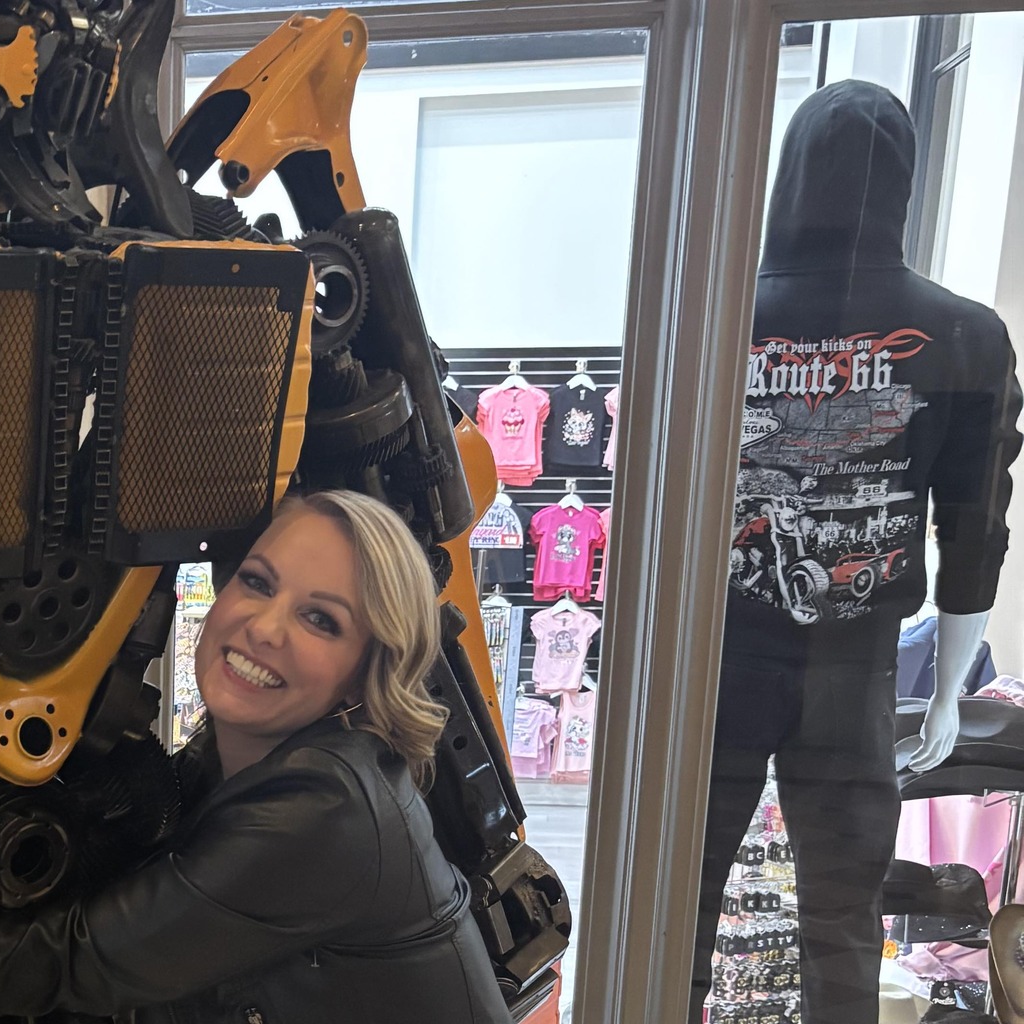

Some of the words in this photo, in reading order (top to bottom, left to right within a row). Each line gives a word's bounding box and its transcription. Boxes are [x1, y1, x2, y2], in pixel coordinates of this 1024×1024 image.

[765, 341, 787, 355] Get
[791, 342, 823, 356] your
[821, 339, 853, 352] kicks
[857, 339, 872, 350] on
[745, 353, 837, 397] Route
[851, 350, 893, 393] 66
[813, 463, 834, 475] The
[836, 461, 879, 474] Mother
[879, 457, 911, 471] Road
